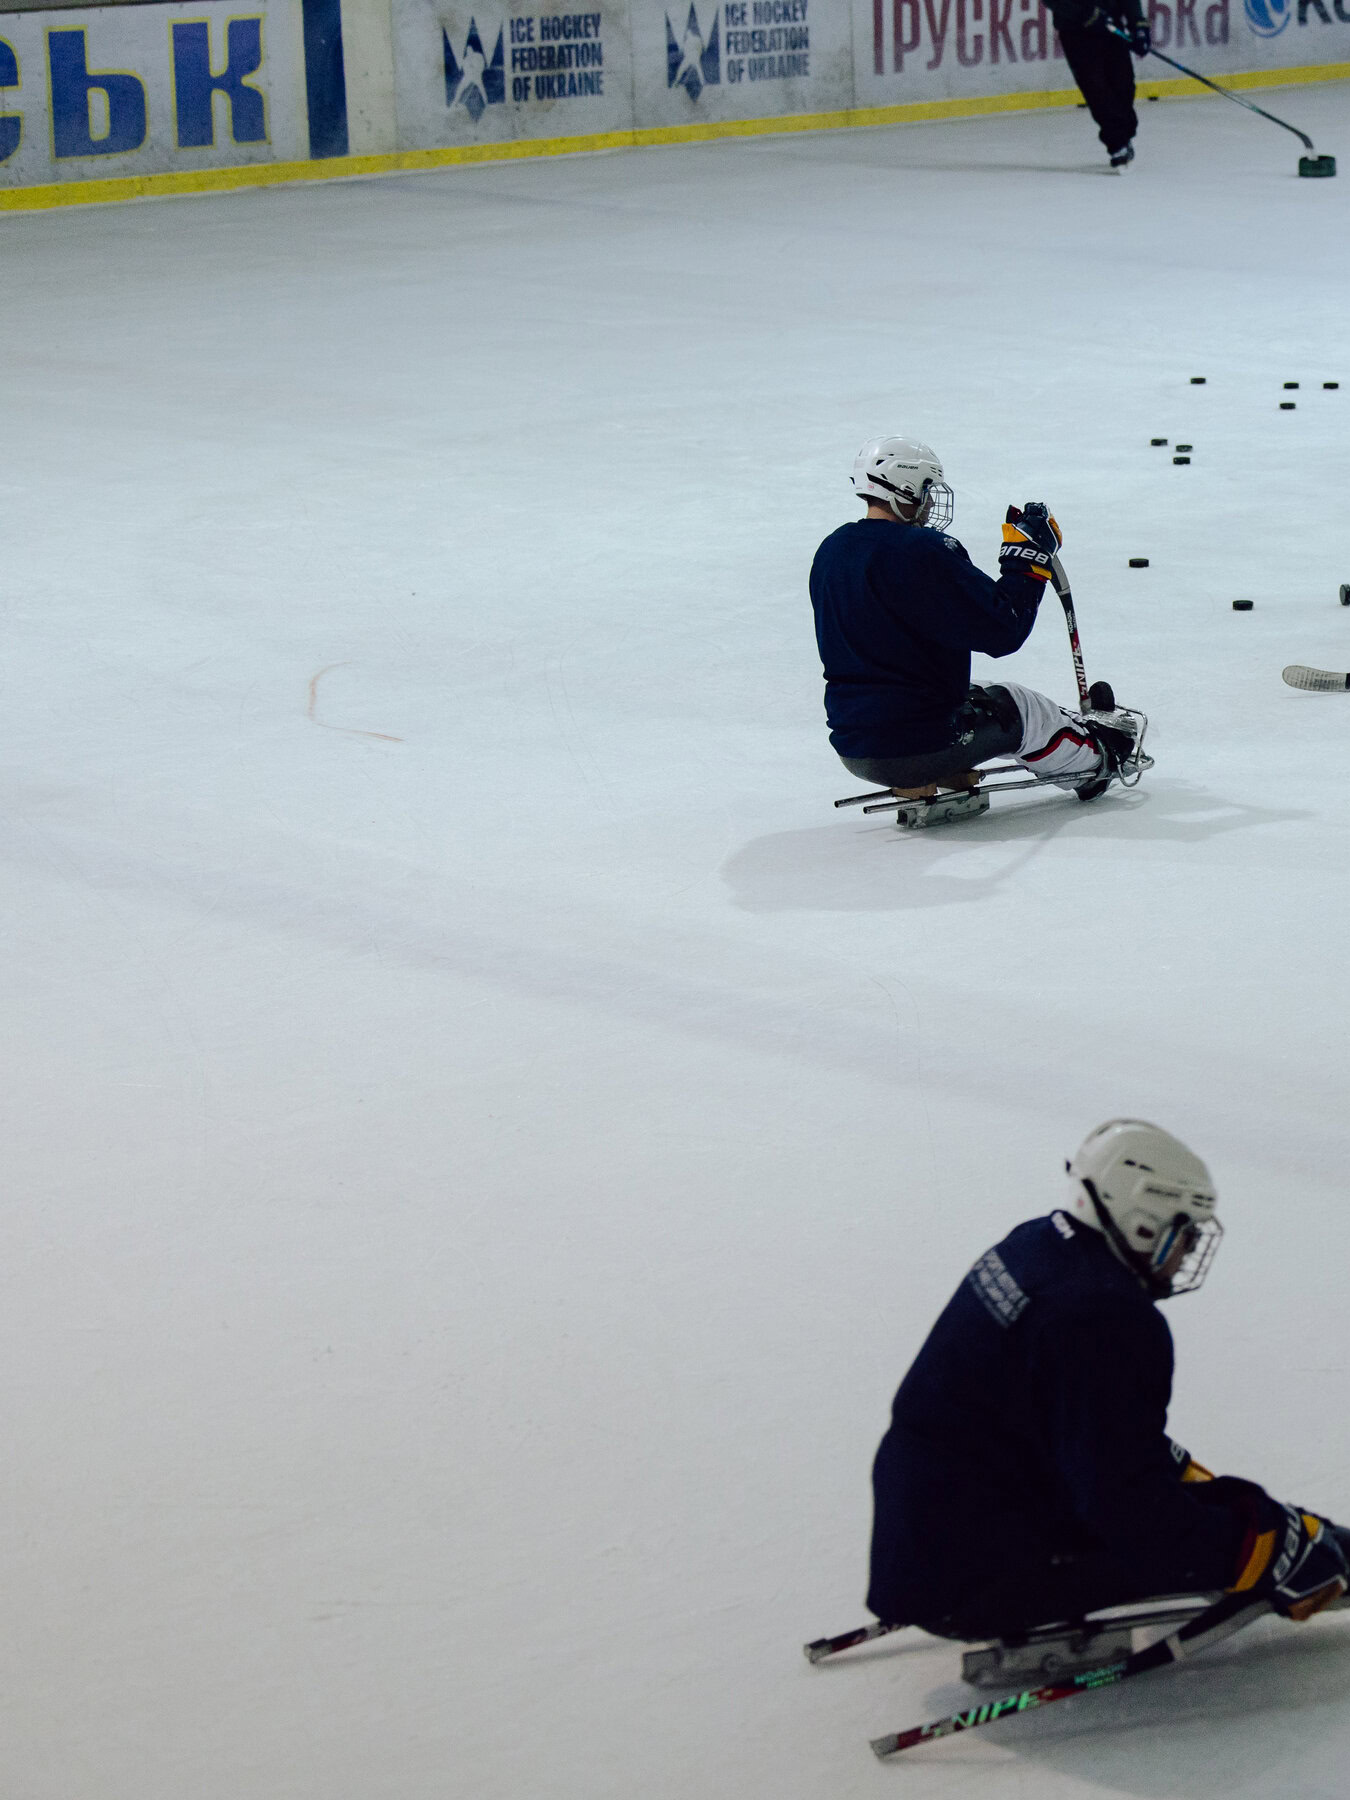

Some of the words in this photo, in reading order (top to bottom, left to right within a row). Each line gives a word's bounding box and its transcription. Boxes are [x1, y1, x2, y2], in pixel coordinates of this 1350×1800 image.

[510, 16, 534, 44] ICE
[540, 12, 601, 40] HOCKEY
[726, 2, 747, 28] ICE
[753, 0, 808, 25] HOCKEY
[726, 26, 809, 55] FEDERATION
[511, 42, 602, 73] FEDERATION
[727, 59, 744, 84] OF
[748, 54, 809, 82] UKRAINE
[0, 13, 271, 163] ЬК
[512, 75, 531, 102] OF
[535, 71, 604, 100] UKRAINE
[1000, 545, 1049, 565] BAUE
